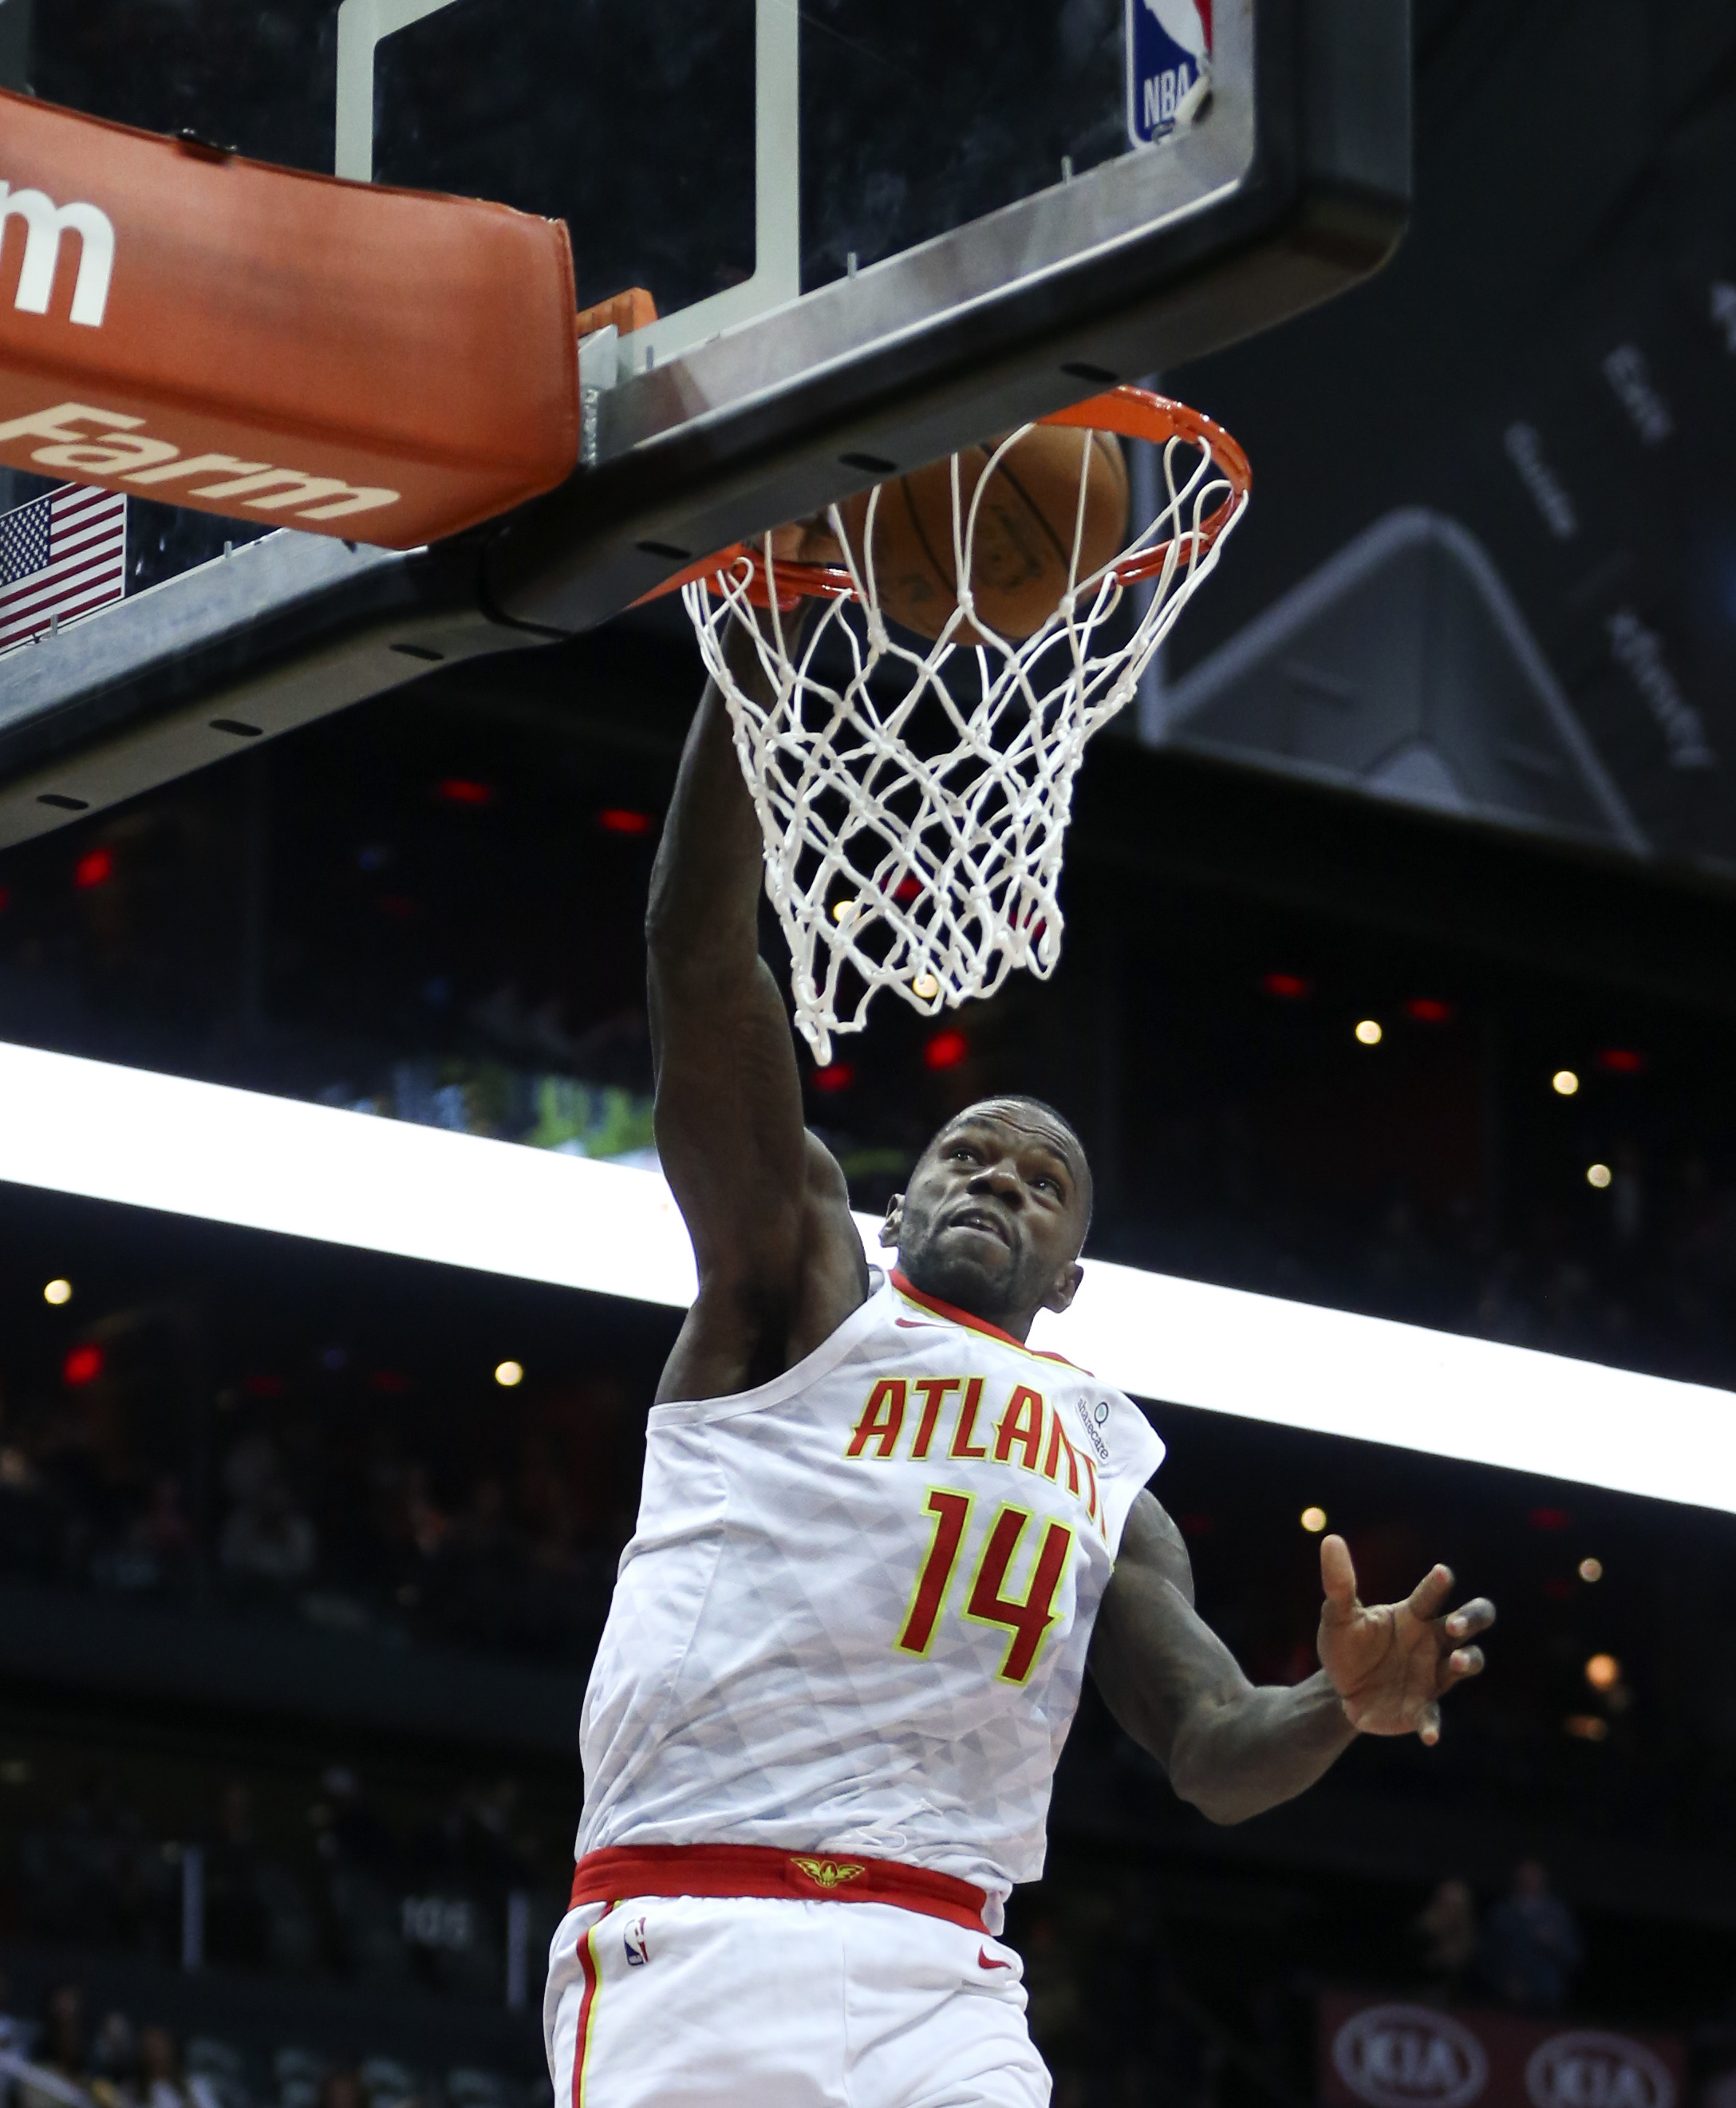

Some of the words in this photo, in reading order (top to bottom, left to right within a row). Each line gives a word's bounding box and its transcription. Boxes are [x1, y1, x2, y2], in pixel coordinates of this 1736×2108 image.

[1143, 61, 1191, 130] NBA
[0, 402, 401, 520] Farm
[843, 1377, 1108, 1546] ATLANT
[1077, 1398, 1109, 1460] sharecare
[894, 1486, 1076, 1687] 14
